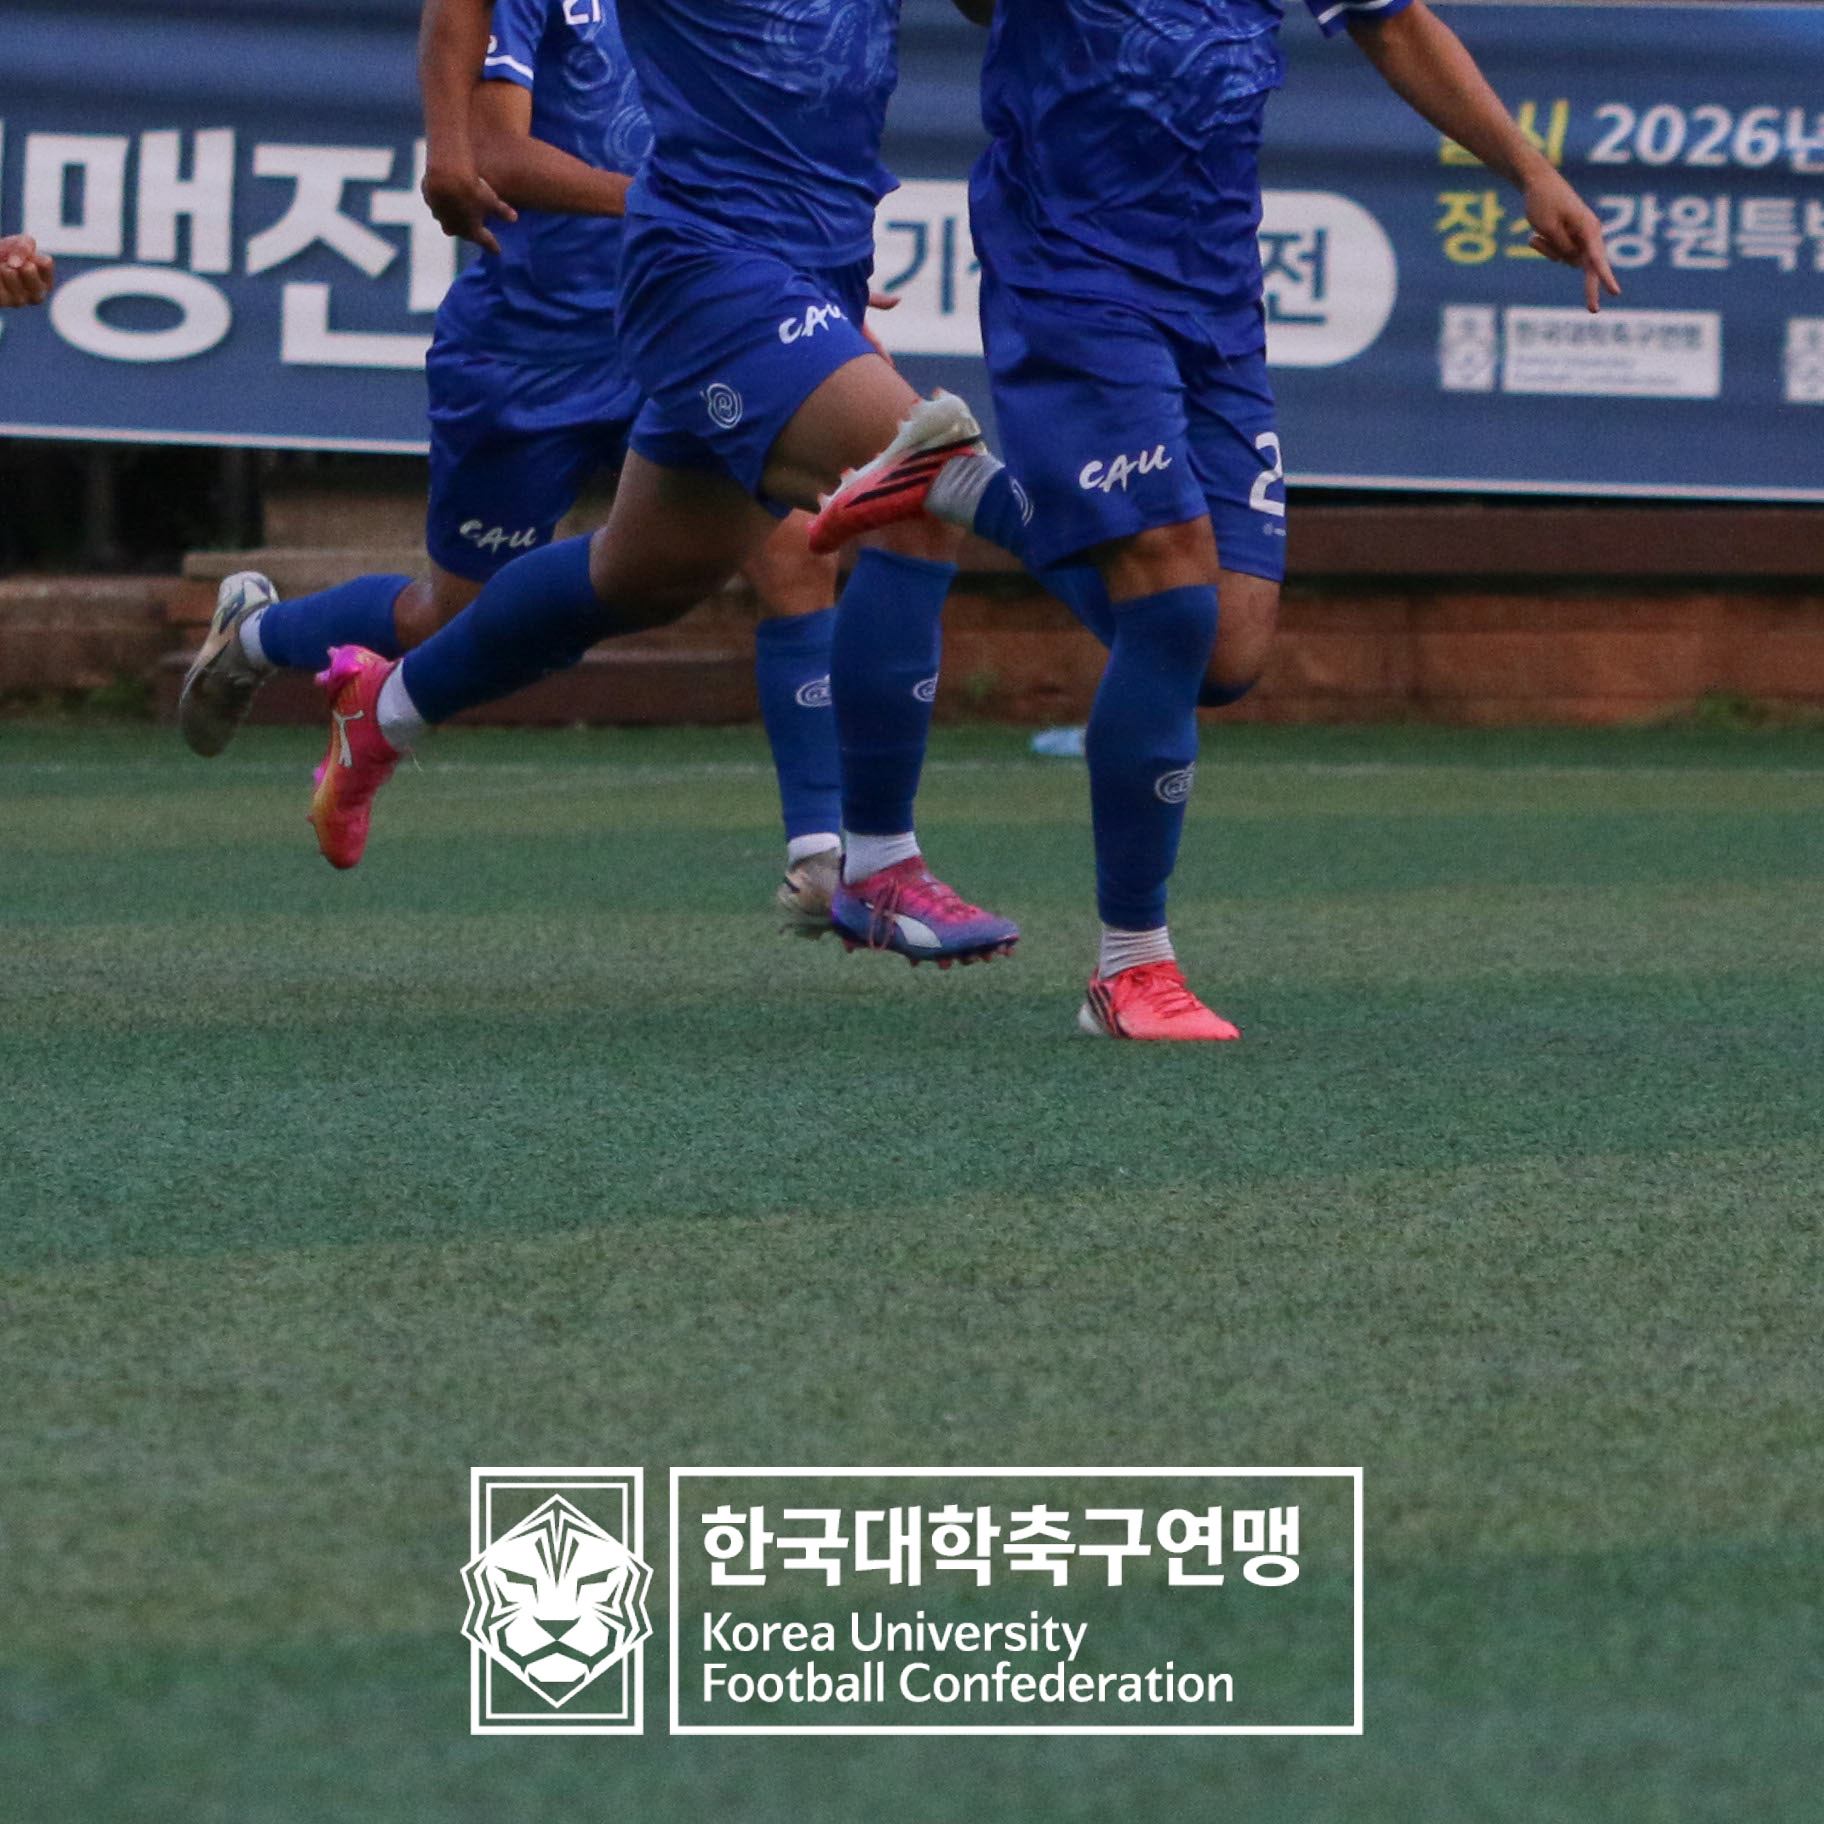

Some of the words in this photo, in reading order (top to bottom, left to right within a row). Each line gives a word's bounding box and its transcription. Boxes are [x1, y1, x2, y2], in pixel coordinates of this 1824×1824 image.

[1078, 444, 1173, 493] CAU
[1249, 431, 1284, 517] 2
[459, 519, 537, 553] CAU
